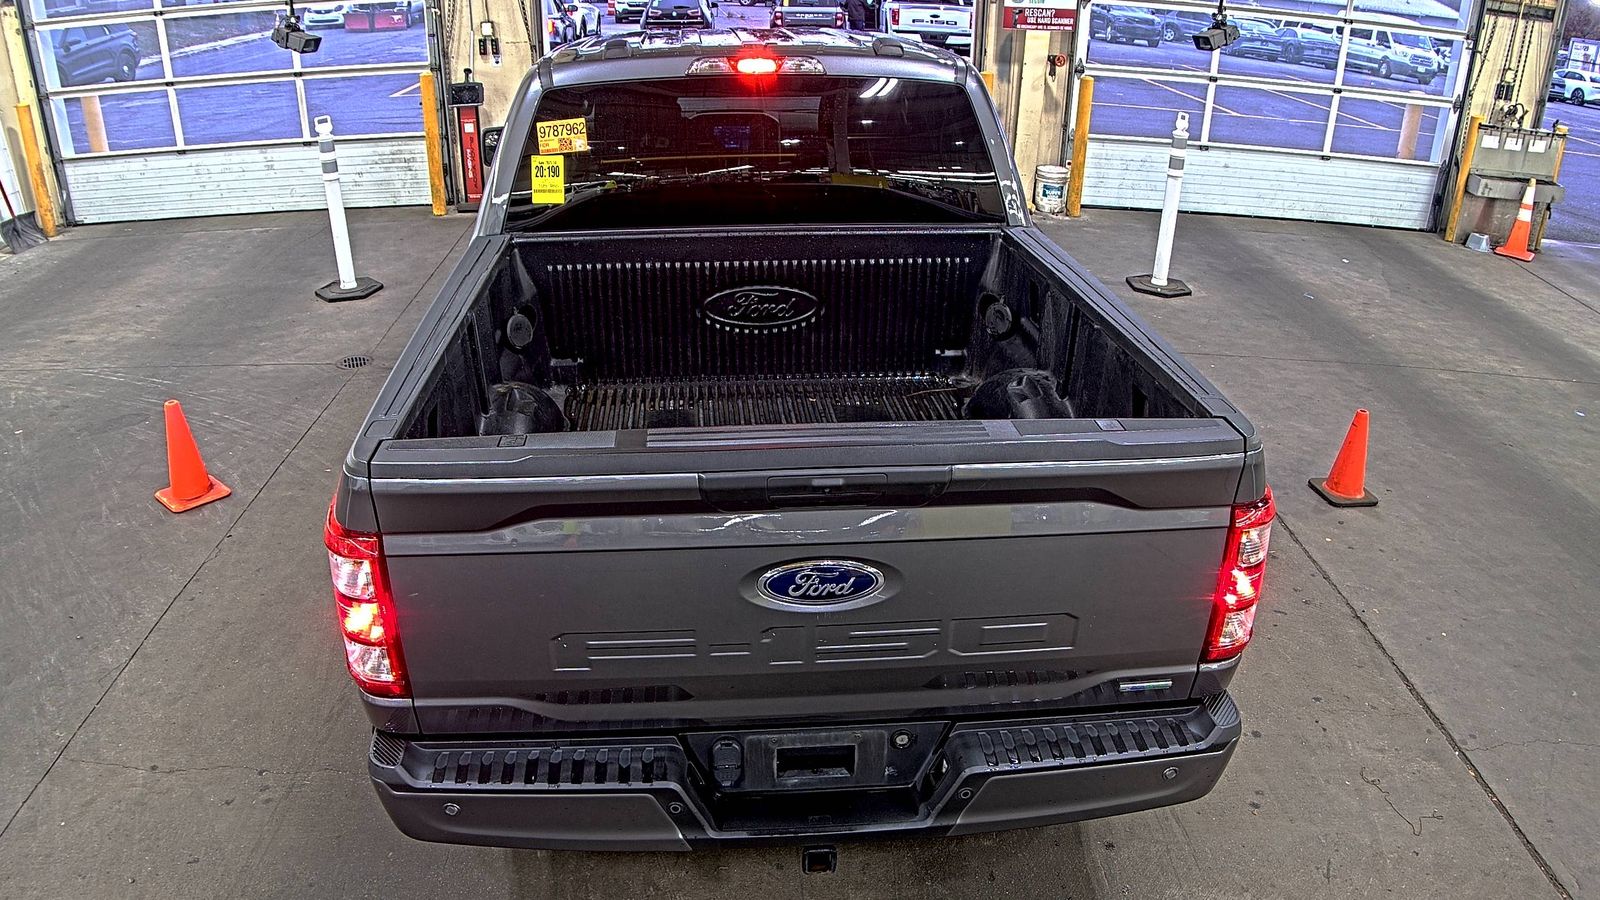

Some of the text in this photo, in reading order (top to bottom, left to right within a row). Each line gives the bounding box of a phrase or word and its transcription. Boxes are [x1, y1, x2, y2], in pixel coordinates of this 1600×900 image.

[1024, 8, 1056, 18] RESCAN?
[538, 122, 586, 139] 9787962
[534, 165, 560, 178] 20:190
[727, 291, 796, 318] Ford
[788, 569, 856, 597] Ford
[550, 613, 1079, 671] F-150
